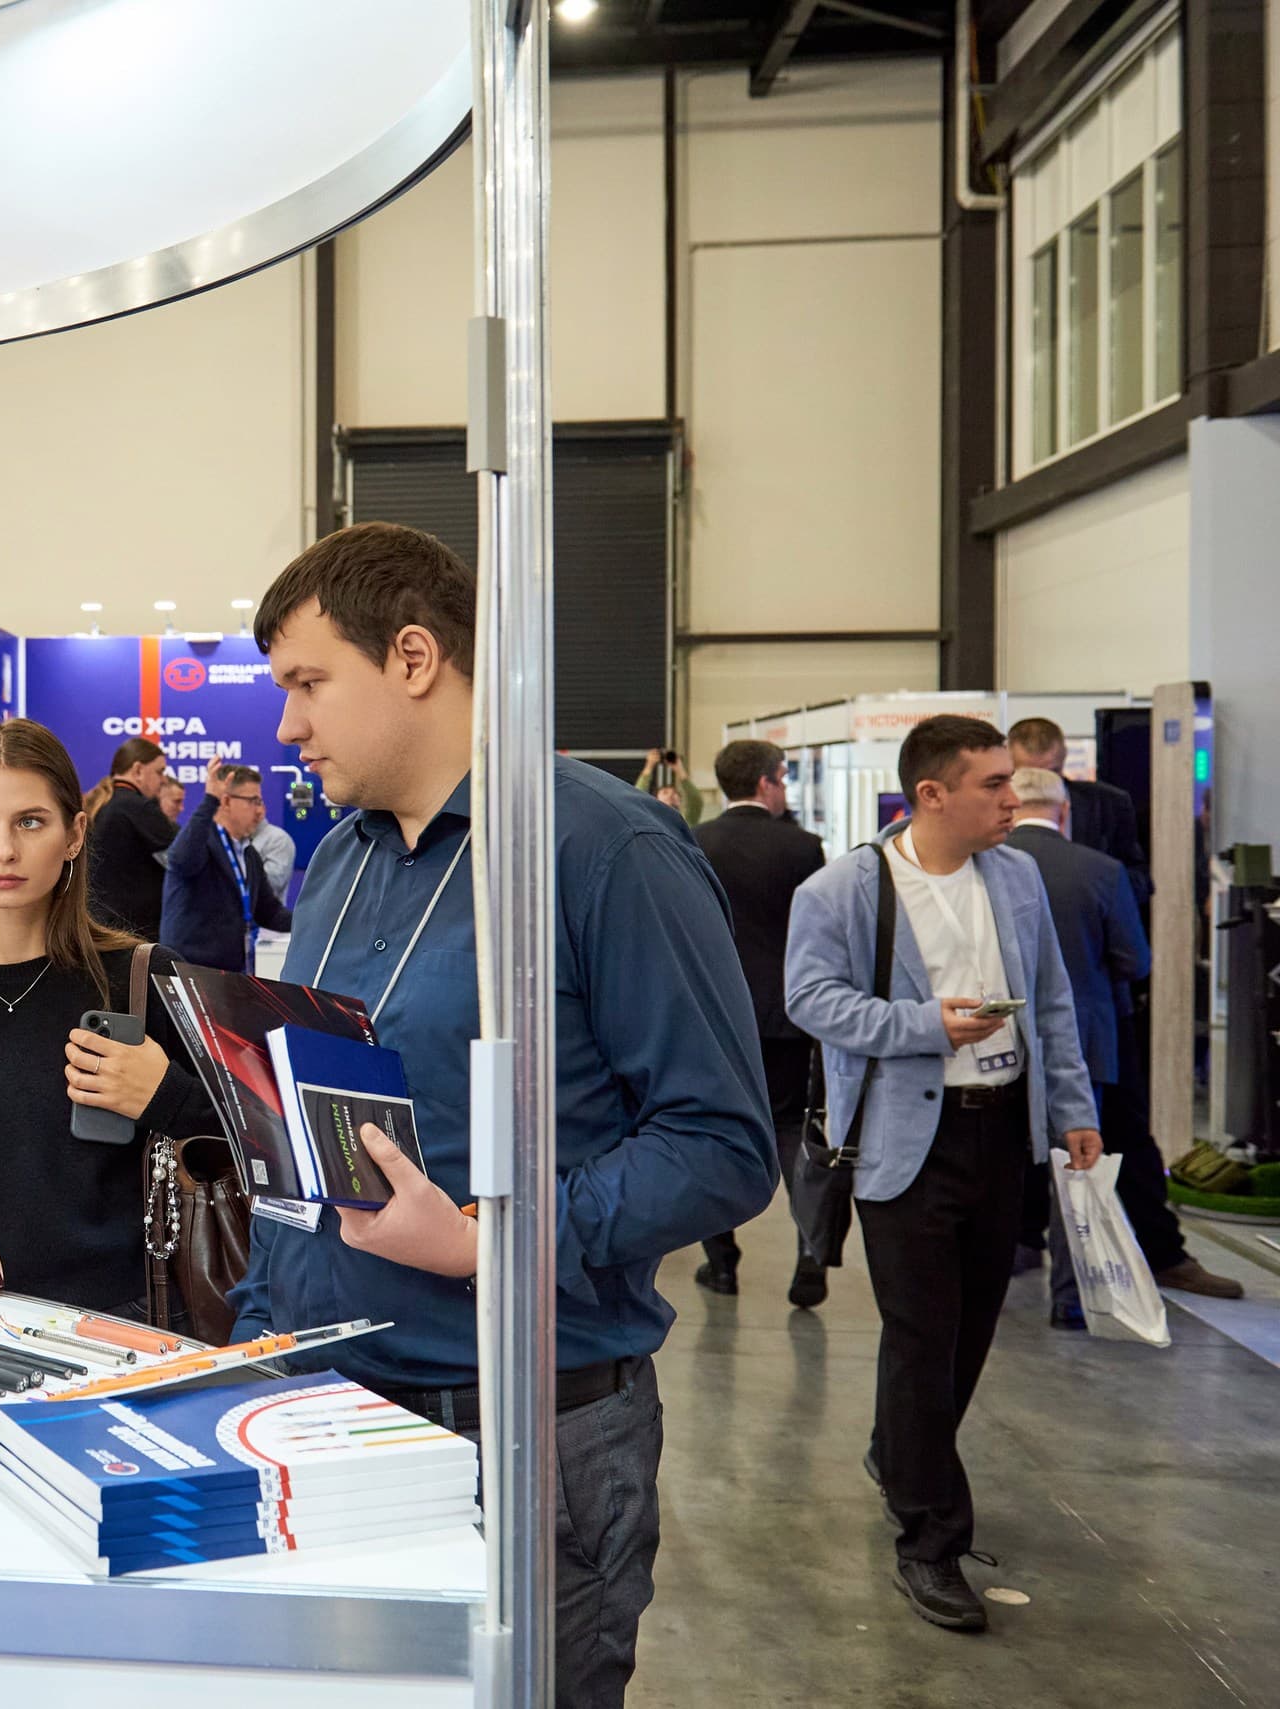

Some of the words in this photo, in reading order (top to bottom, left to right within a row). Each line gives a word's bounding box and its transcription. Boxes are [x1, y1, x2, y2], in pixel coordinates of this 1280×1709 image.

[102, 716, 207, 736] СОХРА
[158, 740, 241, 760] НЯЕМ
[331, 1102, 355, 1172] WINNUM
